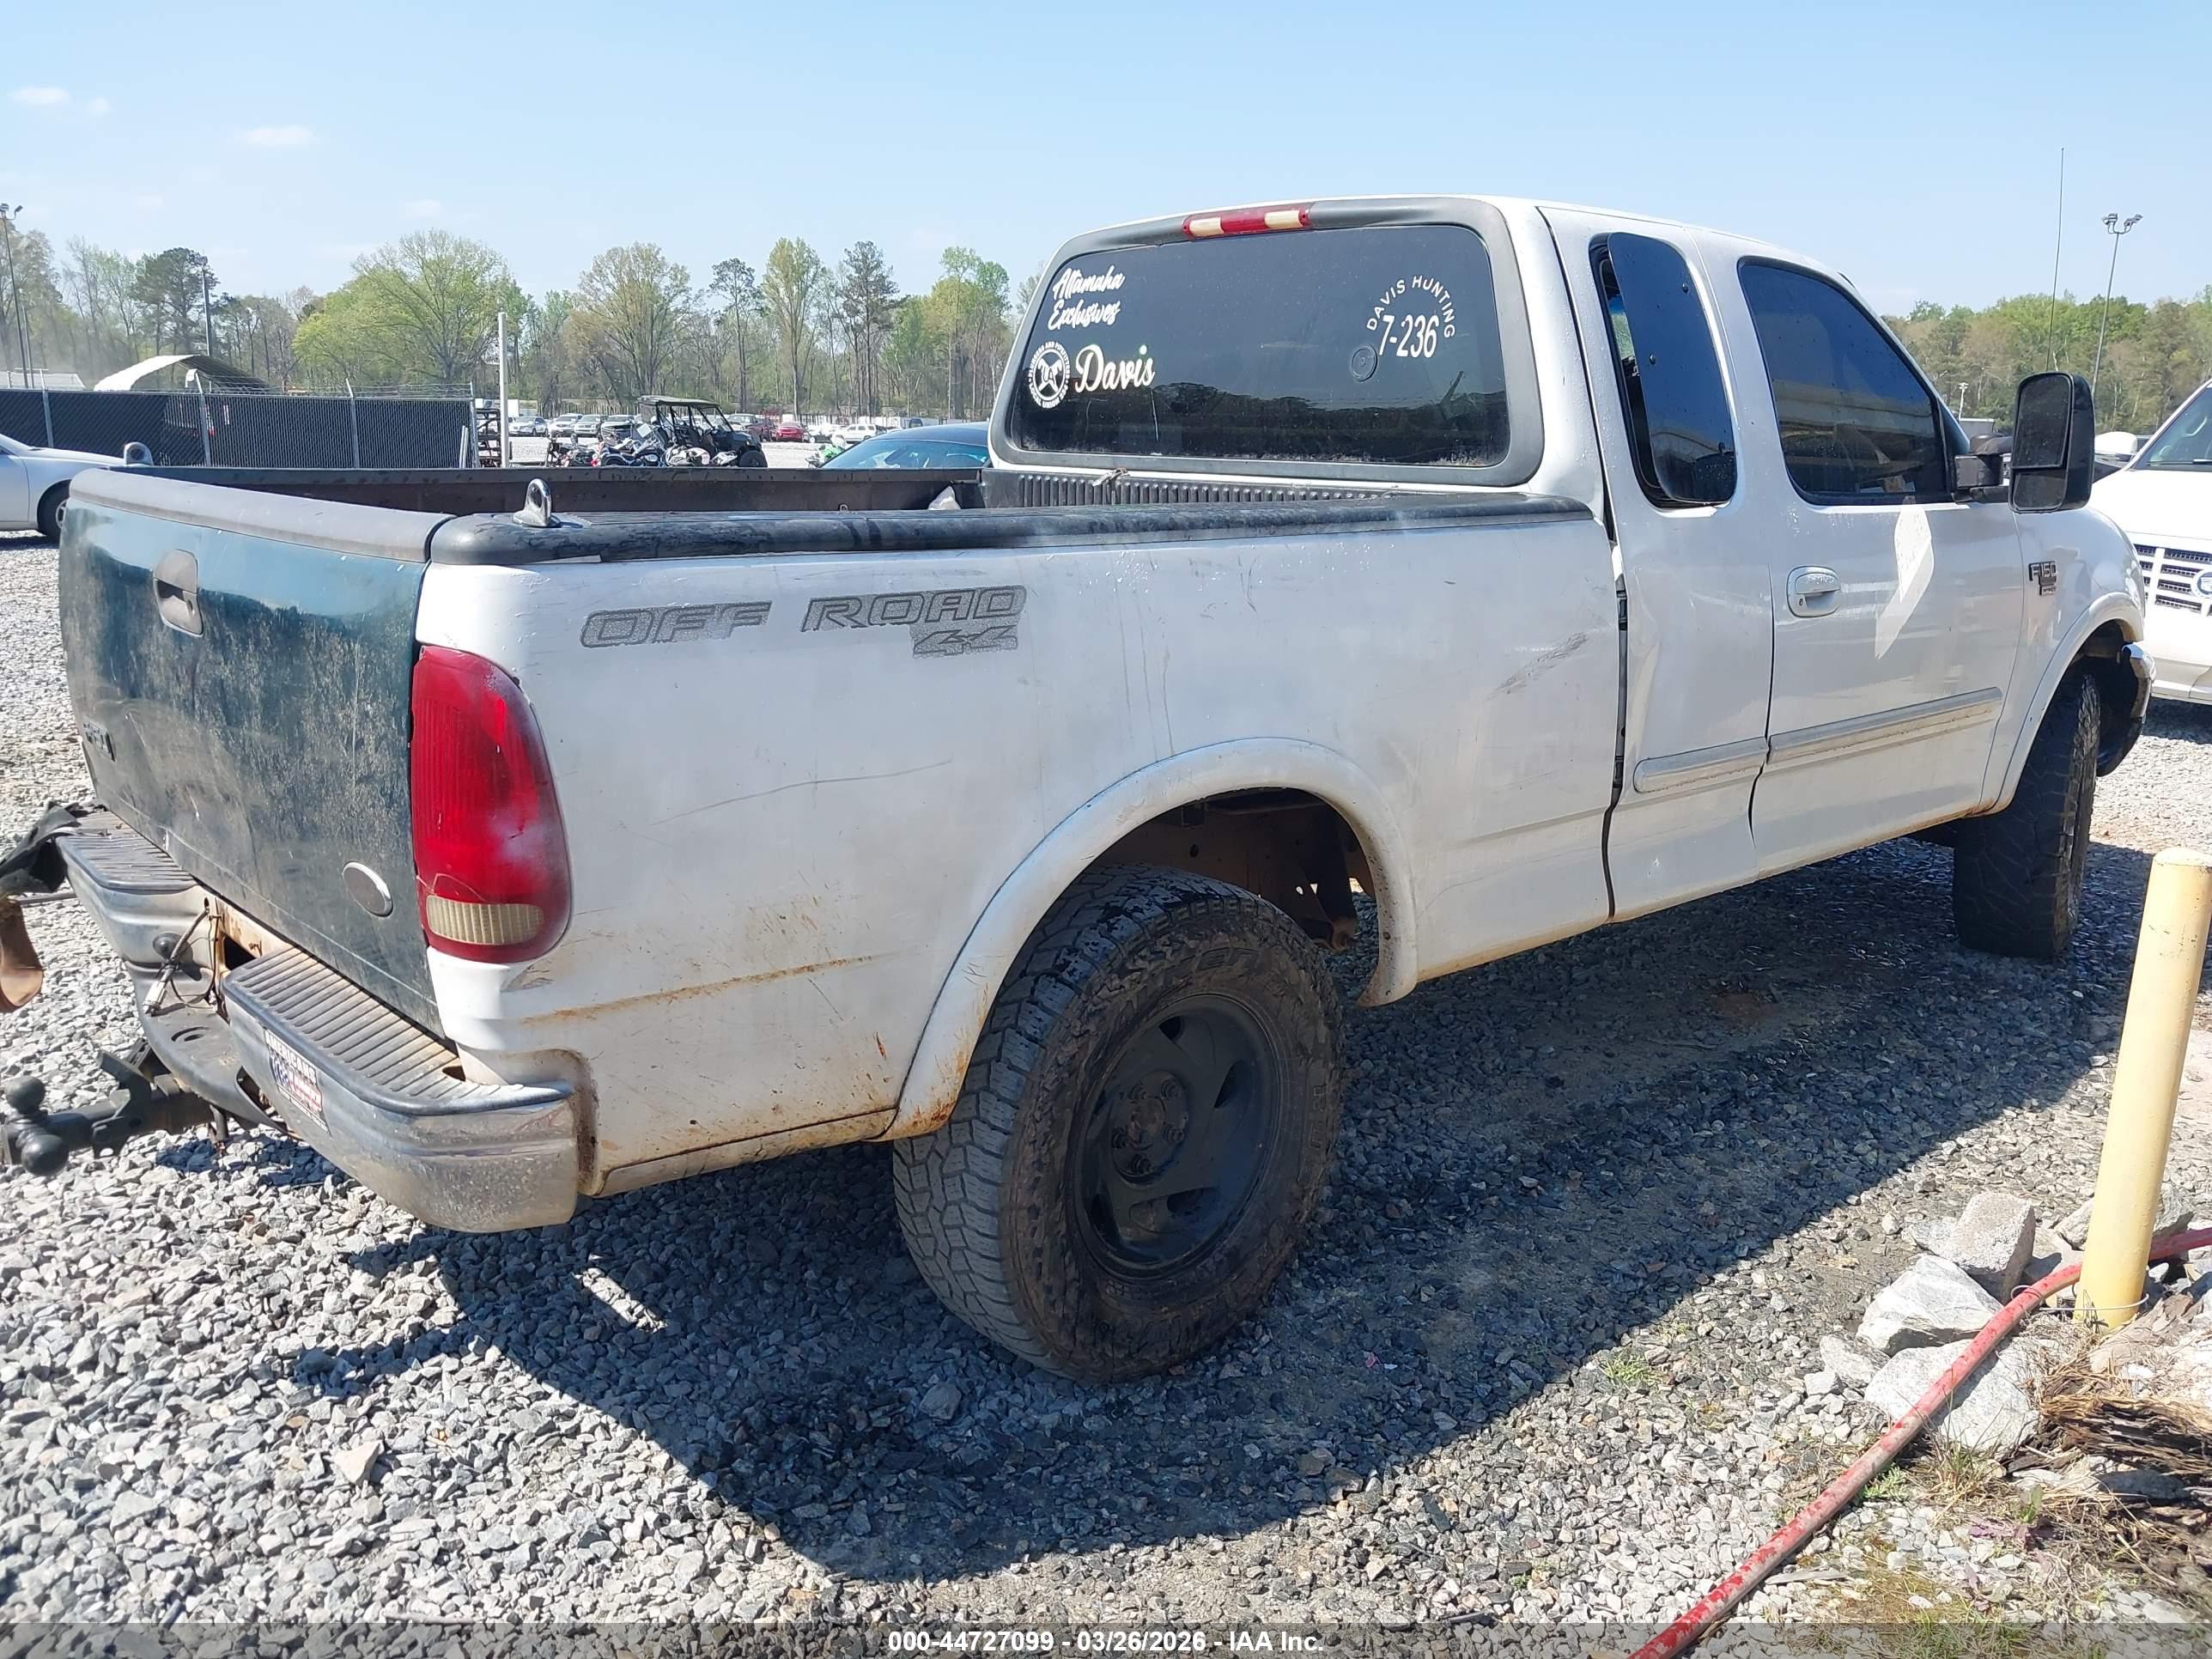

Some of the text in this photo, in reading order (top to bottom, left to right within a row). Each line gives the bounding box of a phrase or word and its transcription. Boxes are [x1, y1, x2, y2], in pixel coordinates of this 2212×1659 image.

[1048, 299, 1121, 331] Exclusives
[1366, 275, 1456, 338] DAVIS HUNTING
[1379, 313, 1440, 358] 7-236
[1074, 343, 1157, 393] Davis
[1029, 383, 1042, 406] LOCAL
[580, 584, 1027, 648] OFF ROAD
